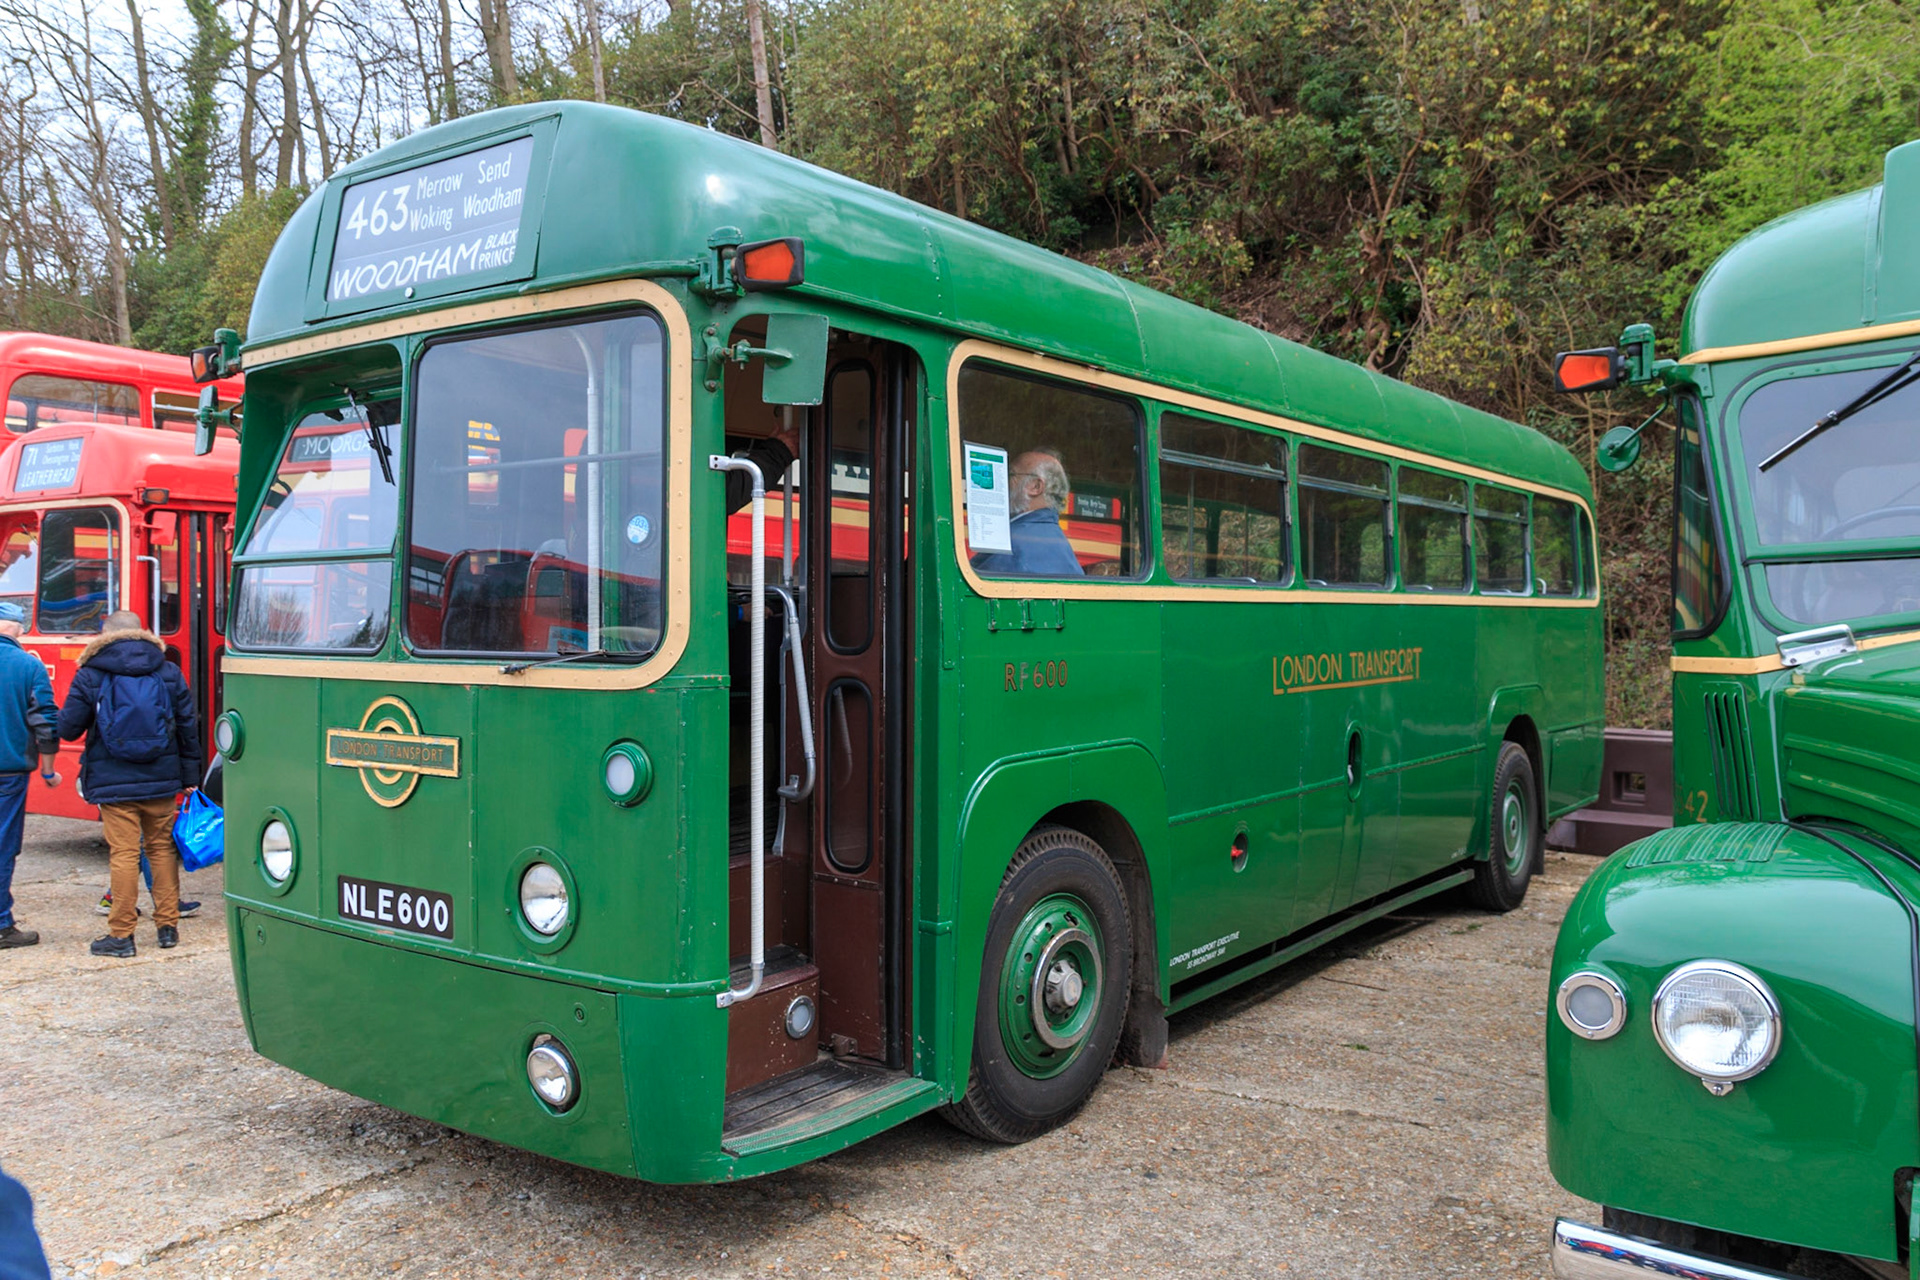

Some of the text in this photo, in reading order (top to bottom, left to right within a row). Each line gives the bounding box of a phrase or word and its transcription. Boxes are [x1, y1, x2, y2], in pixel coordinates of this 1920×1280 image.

[416, 152, 512, 200] Merrow Send
[346, 185, 411, 240] 463
[410, 187, 523, 232] Woking Woodham
[484, 228, 519, 250] BLACK
[333, 238, 482, 299] WOODHAM
[478, 245, 516, 270] PRINCE
[26, 447, 38, 466] 71
[21, 467, 76, 488] LEATHERHEAD
[1273, 647, 1423, 695] LONDON TRANSPORT
[337, 740, 444, 762] LONDON TRANSPORT
[343, 882, 449, 933] NLE600
[1169, 950, 1191, 967] LONDON
[1191, 940, 1217, 957] TRANSPORT
